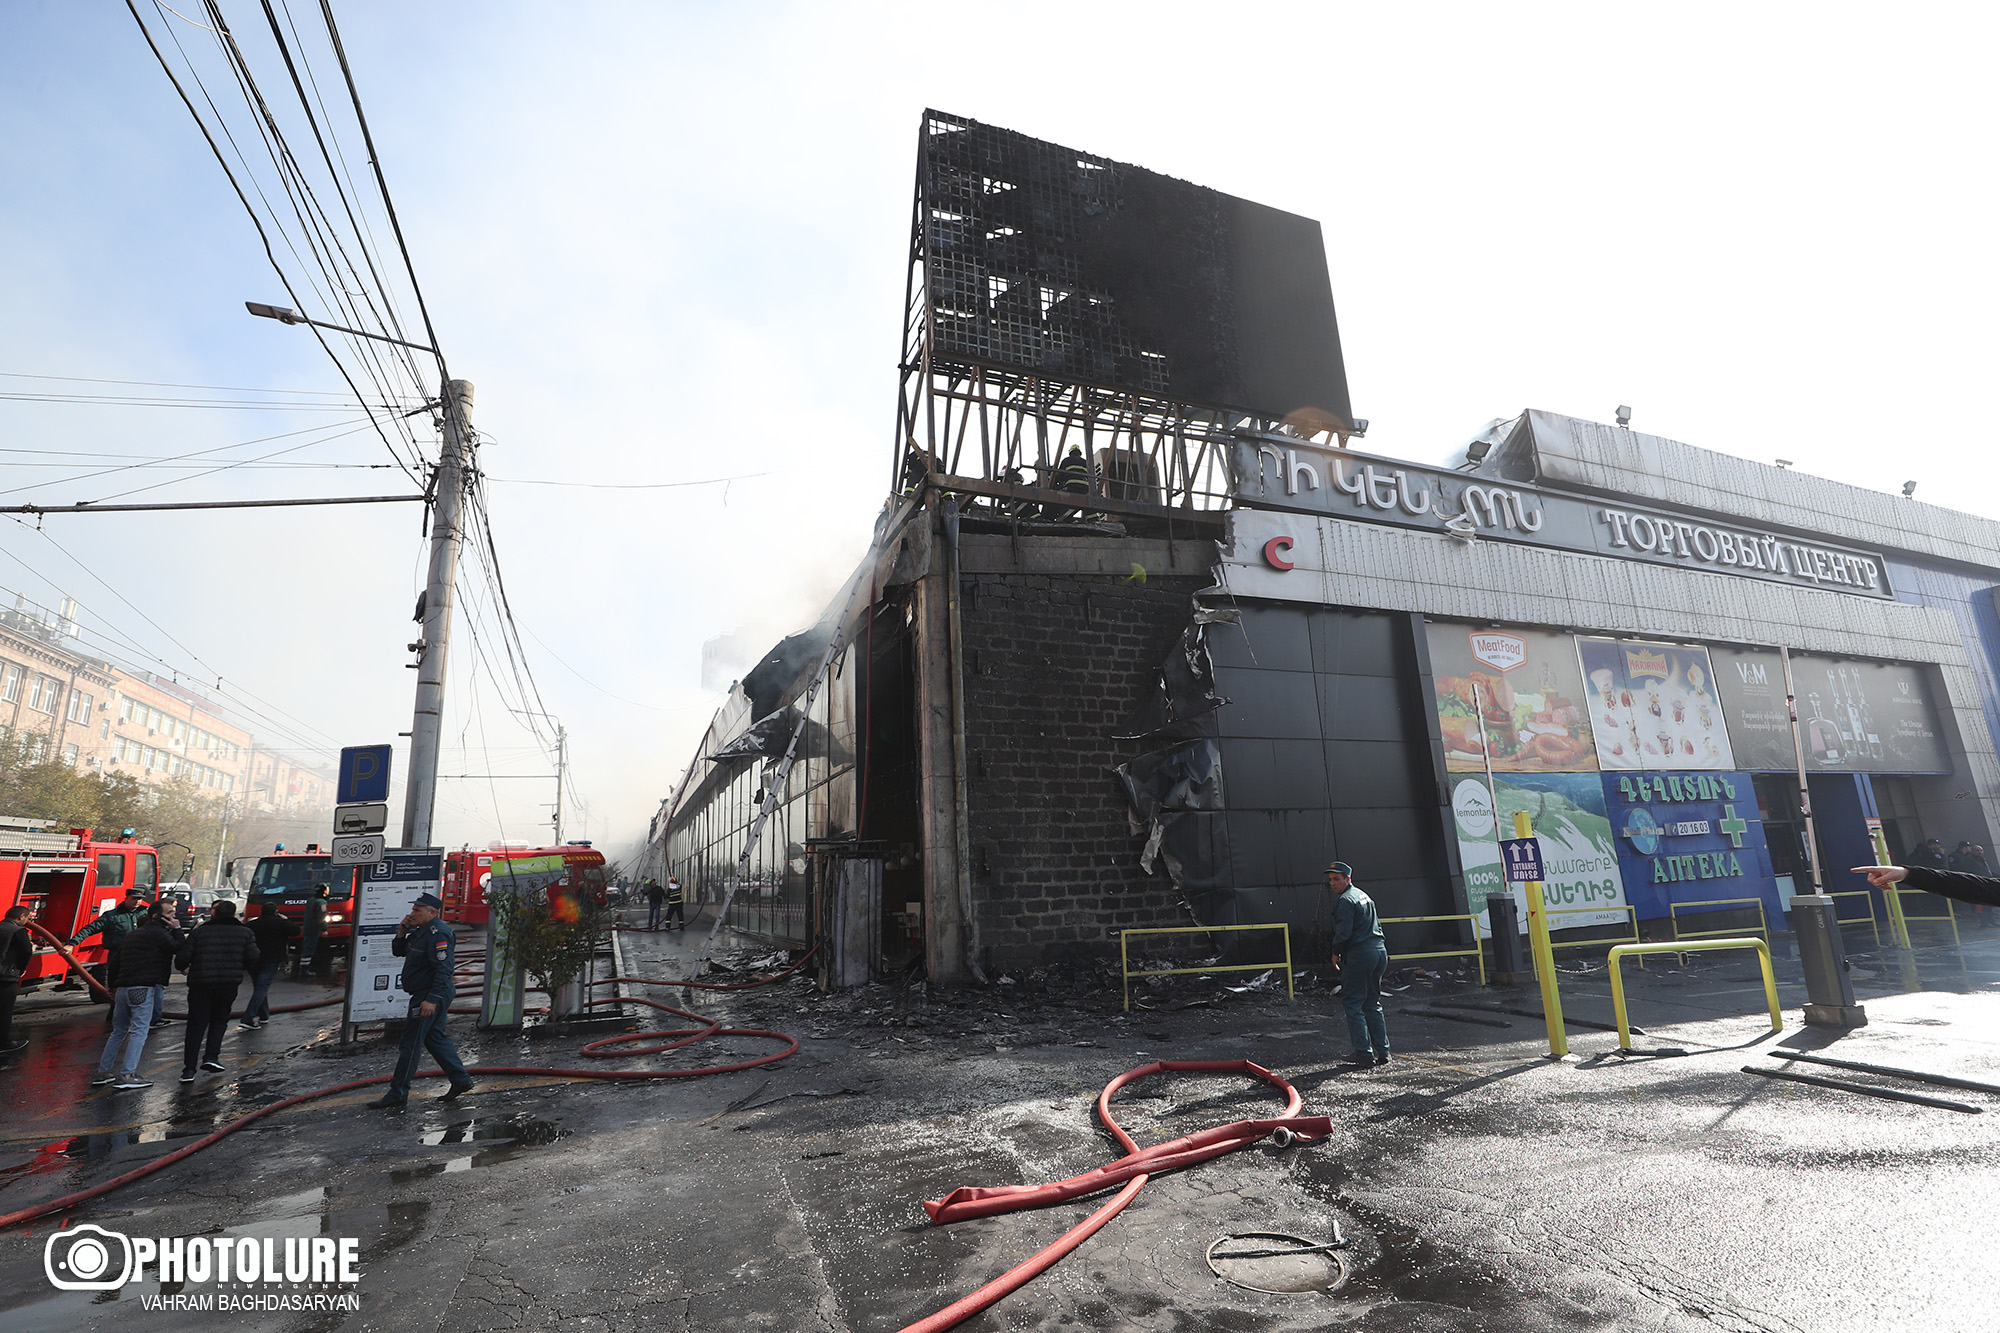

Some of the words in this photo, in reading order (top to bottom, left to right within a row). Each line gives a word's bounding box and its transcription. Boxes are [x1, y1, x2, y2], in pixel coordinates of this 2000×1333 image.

[1602, 509, 1788, 574] ТОРГОВЫЙ
[1790, 545, 1878, 589] ЦЕНТР
[1477, 639, 1520, 655] MeatFood
[1629, 659, 1666, 672] MARIANNA
[1736, 662, 1768, 684] V&M
[350, 752, 379, 796] P
[1620, 775, 1736, 803] ԴԵՂԱՏՈՒՆ
[1680, 824, 1688, 834] 20
[1691, 823, 1699, 833] 16
[1700, 822, 1709, 832] 03
[340, 847, 348, 855] 10
[349, 846, 358, 855] 15
[361, 844, 373, 855] 20
[1513, 862, 1538, 870] ENTRANCE
[1654, 852, 1744, 883] АПТЕКА
[1468, 872, 1499, 886] 100%
